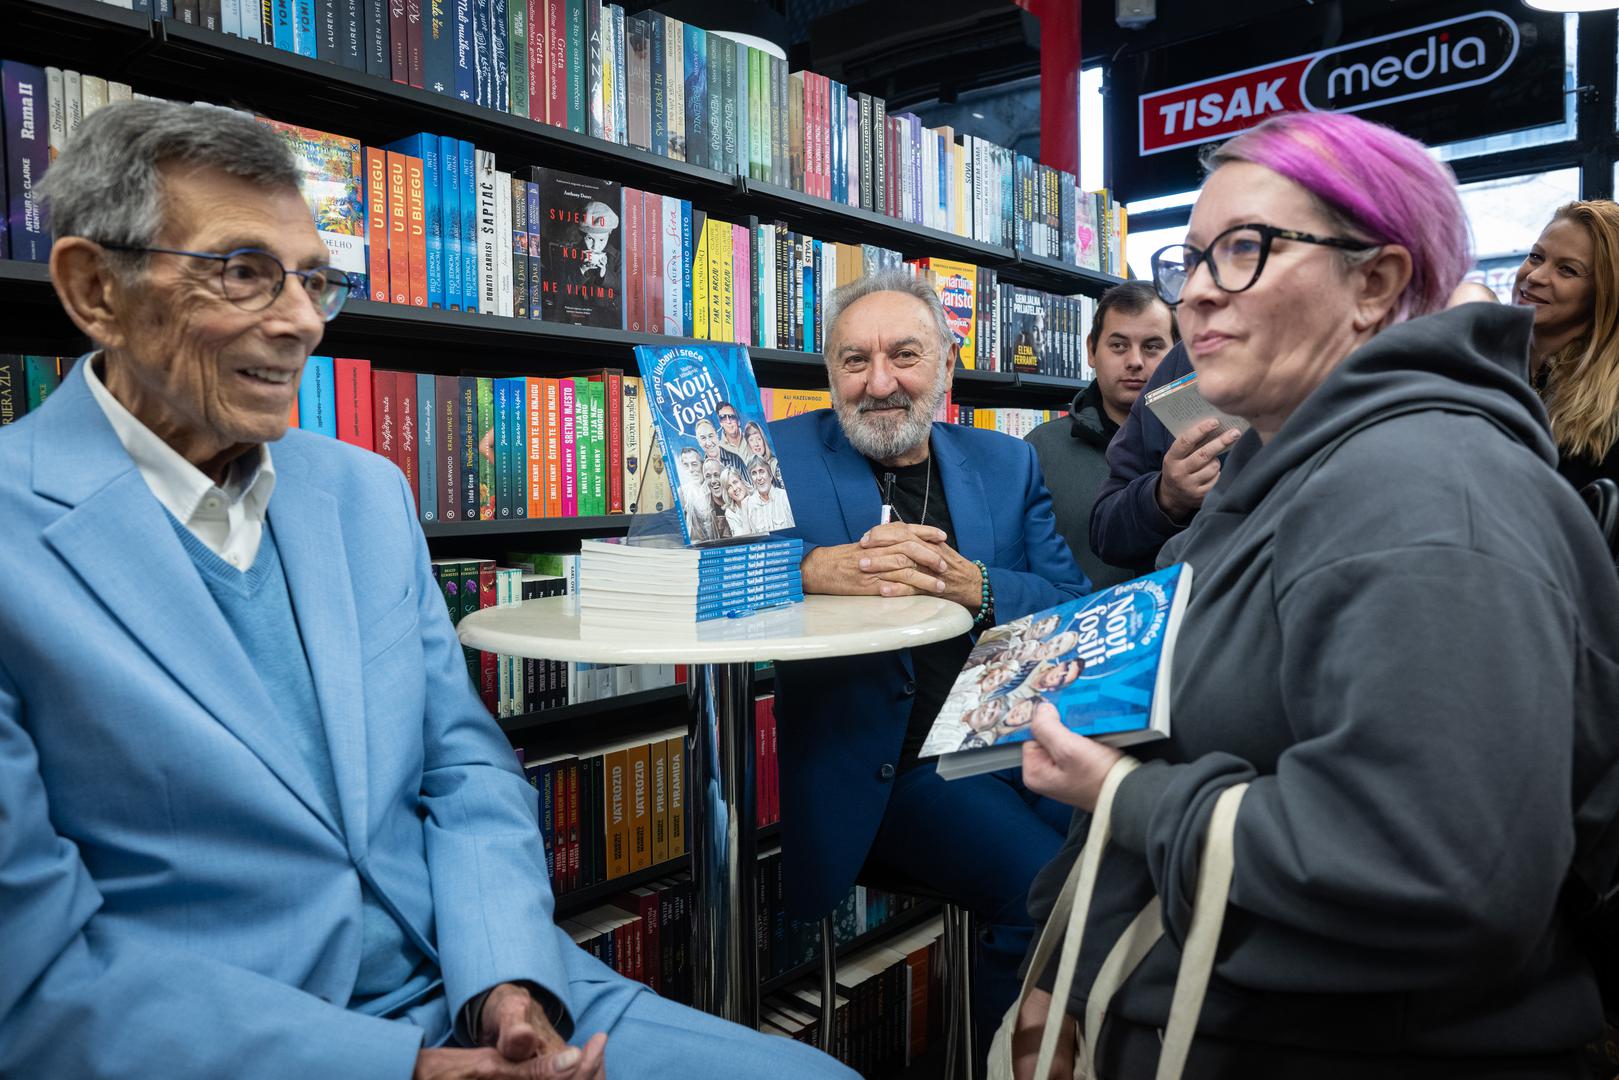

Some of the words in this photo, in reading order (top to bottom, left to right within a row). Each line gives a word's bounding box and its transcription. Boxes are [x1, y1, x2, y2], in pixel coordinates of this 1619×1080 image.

[459, 23, 469, 69] muškarci
[536, 33, 544, 64] Greta
[557, 38, 565, 69] Greta
[590, 30, 601, 93] ANNA
[18, 82, 32, 95] II
[1159, 77, 1287, 135] TISAK
[1327, 32, 1486, 99] media
[51, 97, 62, 132] Strijelac
[655, 88, 663, 119] PROTIV
[21, 98, 35, 140] Rama
[711, 94, 719, 151] MEDVEDGRAD
[726, 98, 734, 154] MEDVEDGRAD
[22, 158, 32, 189] CLARKE
[372, 159, 383, 213] BIJEGU
[393, 163, 403, 217] BIJEGU
[411, 167, 421, 221] BIJEGU
[25, 200, 33, 232] ARTHUR
[479, 182, 495, 235] ŠAPTAČ
[549, 208, 605, 227] SVJETLO
[373, 217, 384, 229] U
[394, 221, 404, 232] U
[412, 225, 423, 236] U
[485, 242, 493, 271] CARRISI
[563, 246, 592, 261] KOJE
[683, 250, 691, 288] SIGURNO
[486, 274, 494, 302] DONATO
[543, 281, 558, 293] NE
[567, 284, 614, 298] VIDIMO
[939, 290, 973, 309] varisto
[653, 349, 675, 375] ljubavi
[679, 348, 704, 362] sreće
[1014, 354, 1038, 366] FERRANTE
[1017, 345, 1033, 355] ELENA
[531, 384, 539, 410] KNJIGU
[548, 385, 556, 410] KNJIGU
[653, 375, 665, 404] Bend
[663, 366, 715, 405] Novi
[563, 387, 573, 415] MJESTO
[672, 387, 723, 436] fosili
[464, 423, 472, 433] što
[465, 414, 472, 423] mi
[531, 411, 539, 426] KAO
[531, 427, 539, 435] TE
[548, 411, 556, 427] KAO
[548, 428, 556, 436] TE
[564, 416, 574, 444] SRETNO
[465, 434, 474, 468] Posljednje
[531, 437, 540, 460] ČITAM
[548, 437, 557, 460] ČITAM
[580, 445, 588, 470] HENRY
[594, 448, 602, 473] HENRY
[532, 483, 540, 501] EMILY
[1114, 580, 1146, 596] Bend
[1074, 604, 1108, 669] fosili
[1105, 593, 1136, 659] Novi
[634, 760, 645, 819] VATROZID
[656, 757, 664, 813] PIRAMIDA
[672, 754, 681, 808] PIRAMIDA
[612, 766, 623, 825] VATROZID
